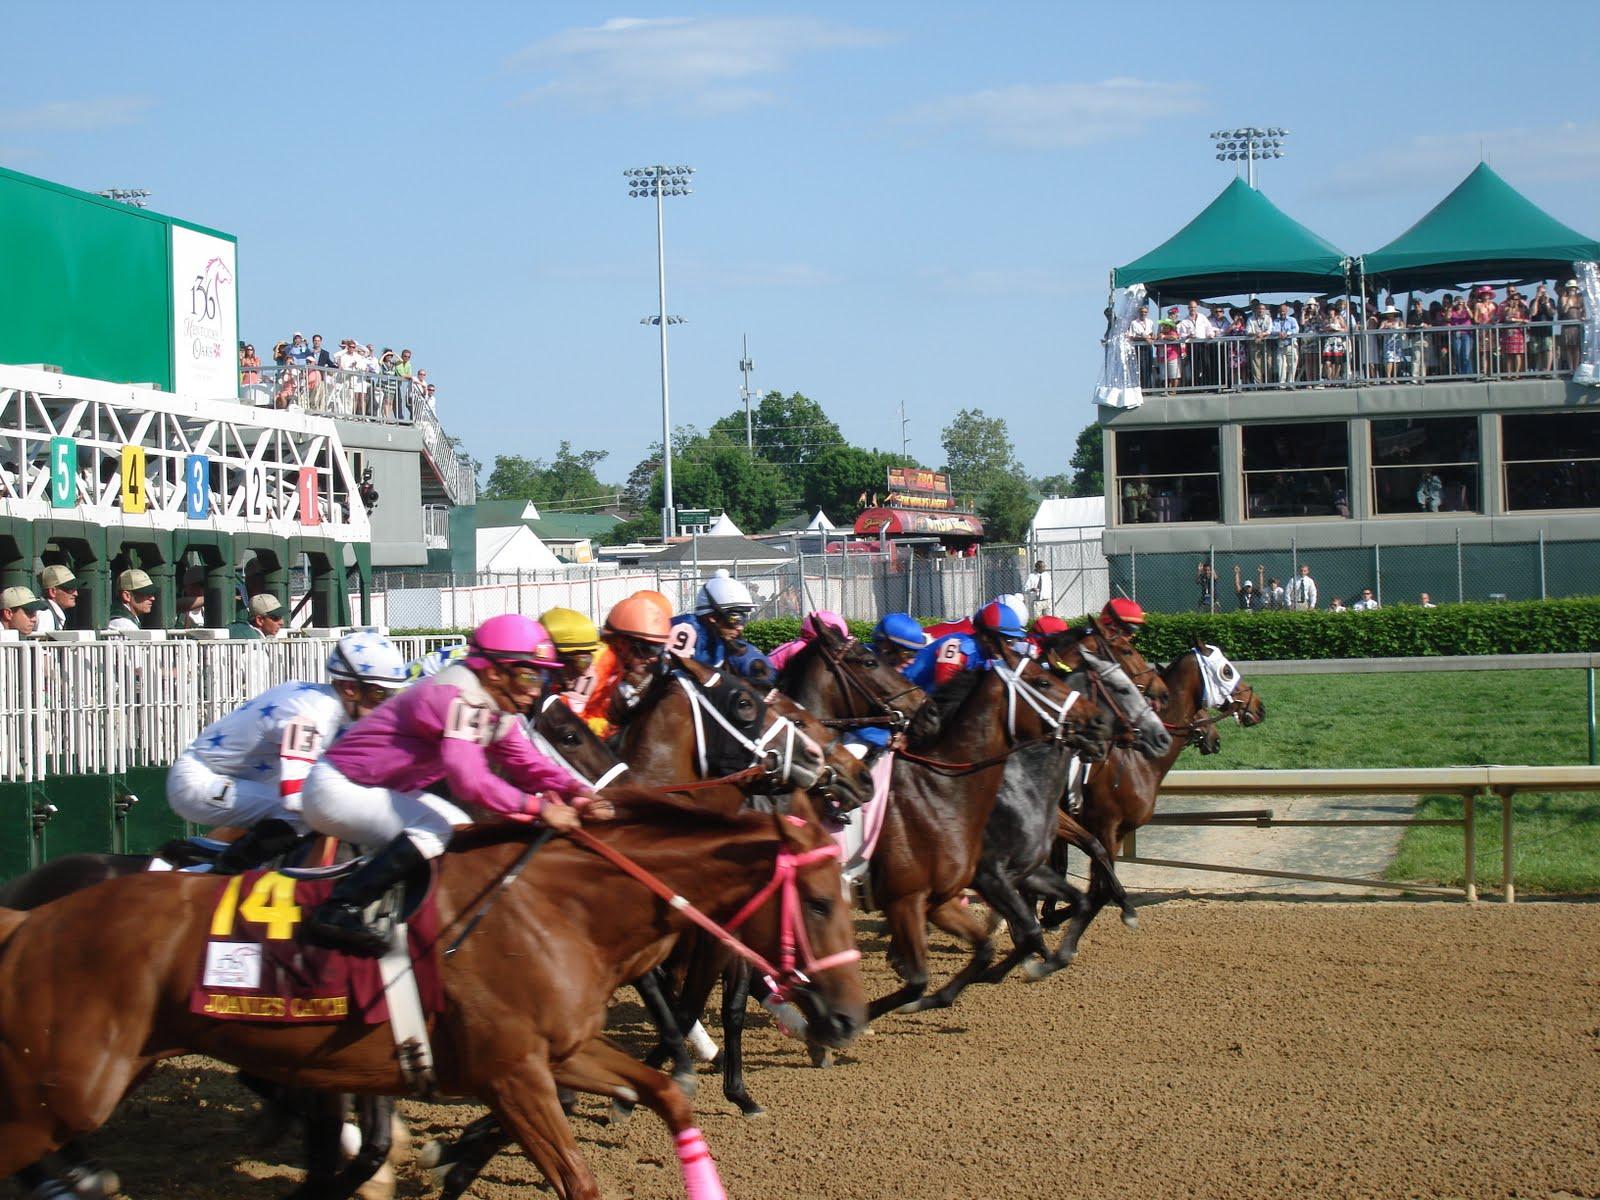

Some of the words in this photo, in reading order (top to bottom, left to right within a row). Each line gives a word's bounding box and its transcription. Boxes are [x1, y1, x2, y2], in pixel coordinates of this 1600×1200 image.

[190, 275, 216, 323] 136
[58, 444, 69, 500] 5
[129, 453, 139, 505] 4
[193, 461, 203, 512] 3
[253, 467, 261, 515] 2
[307, 473, 313, 519] 1
[672, 630, 689, 651] 9
[944, 644, 957, 659] 6
[289, 723, 319, 753] 13
[210, 871, 302, 940] 14
